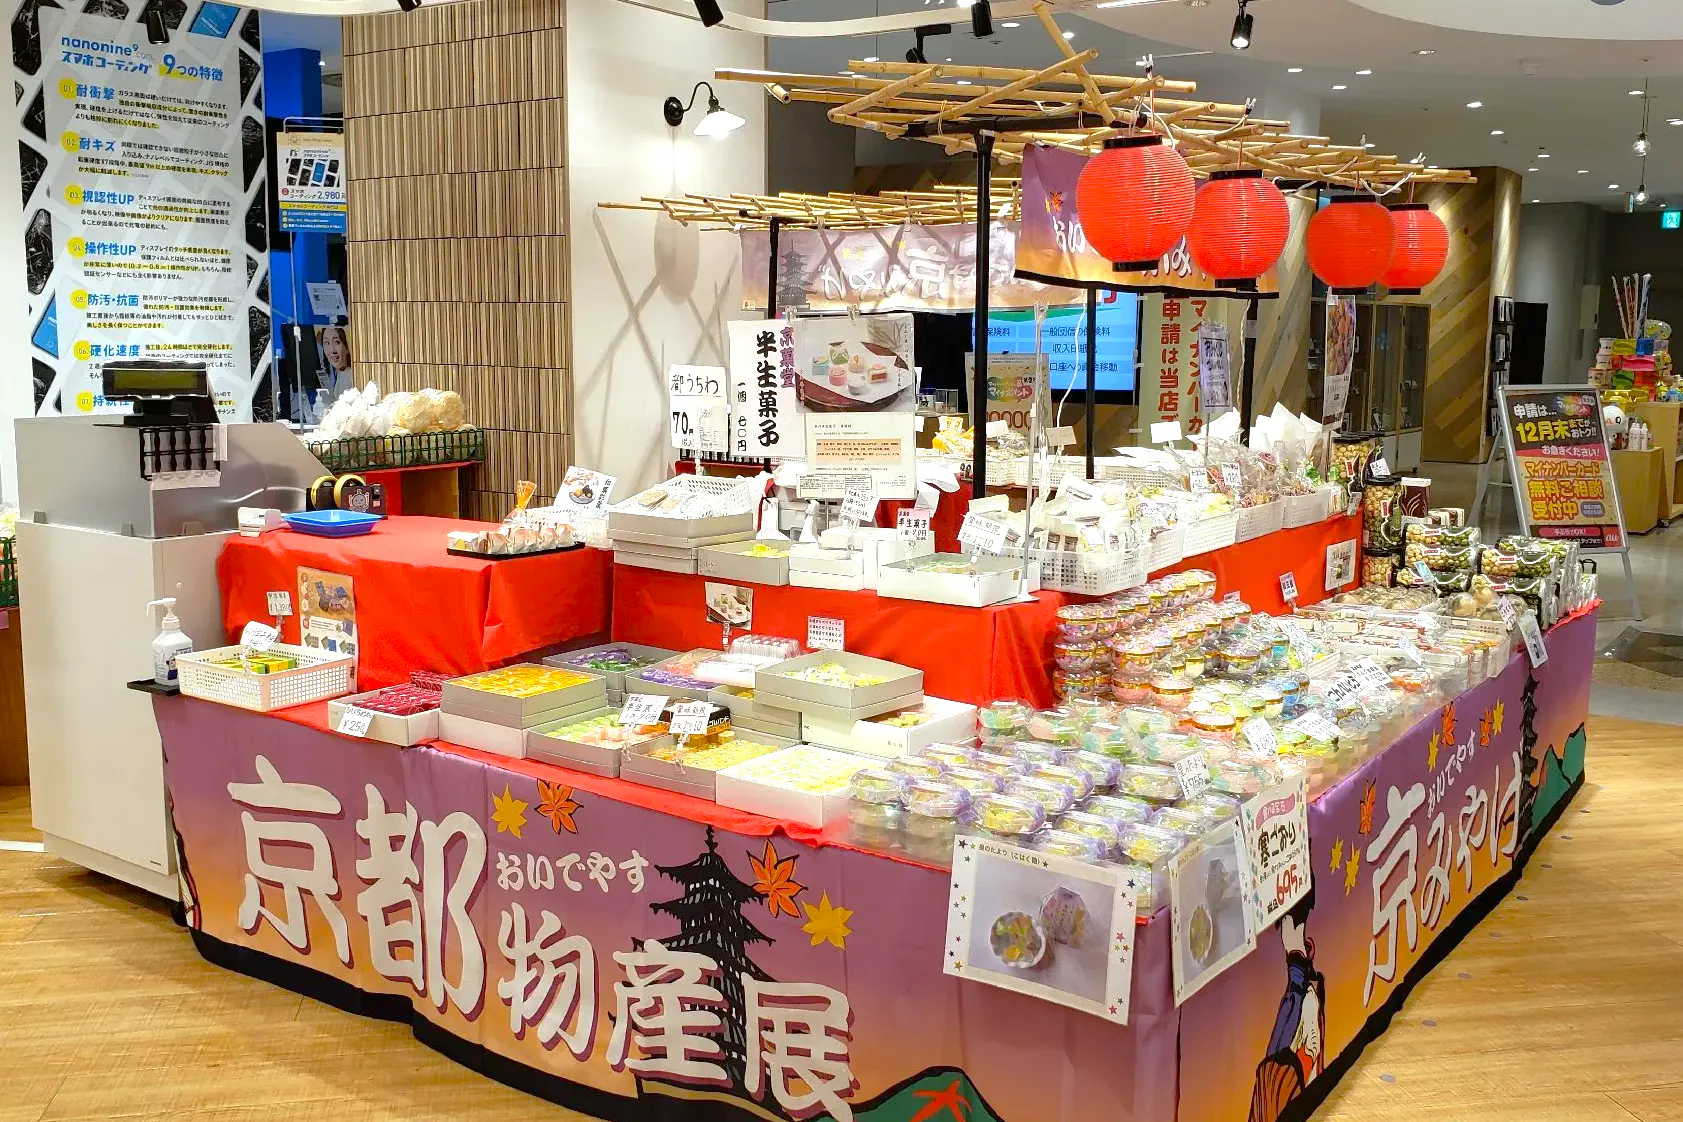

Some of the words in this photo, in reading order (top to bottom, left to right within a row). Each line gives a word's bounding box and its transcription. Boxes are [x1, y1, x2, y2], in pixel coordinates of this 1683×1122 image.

[61, 50, 149, 74] スマホコーティング
[163, 54, 223, 82] 9つの特徴
[76, 84, 115, 100] 耐衝撃
[79, 138, 117, 151] 耐キズ
[83, 190, 134, 204] 視認性UP
[85, 242, 136, 256] 操作性UP
[87, 294, 139, 307] 防汚・抗菌
[90, 345, 140, 357] 硬化速度
[670, 373, 719, 394] 都うちわ
[757, 331, 780, 447] 半生菓子
[1516, 419, 1571, 443] 12月末
[1541, 445, 1600, 457] お急ぎください!
[1525, 461, 1600, 477] マイナンバーカード
[1528, 479, 1604, 500] 無料ご相談
[1532, 499, 1578, 520] 受付中
[898, 518, 928, 529] 半生菓子
[496, 849, 651, 894] おいでやす
